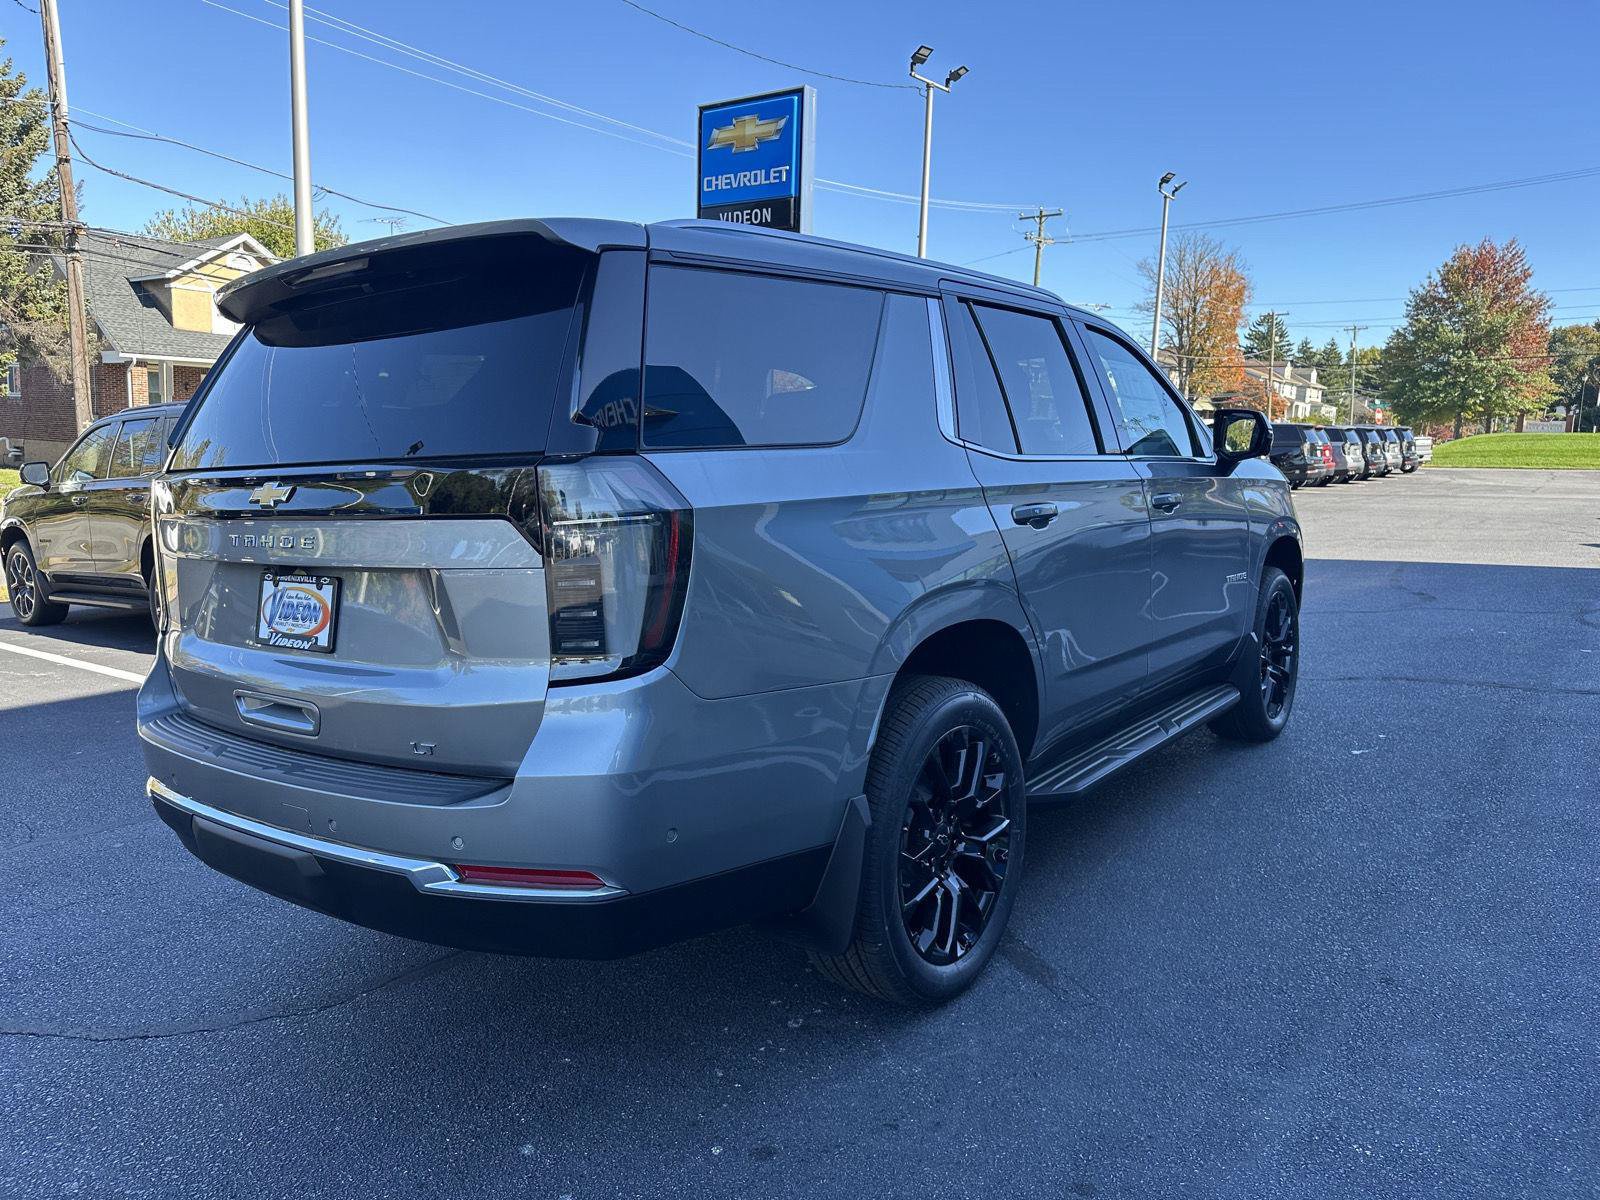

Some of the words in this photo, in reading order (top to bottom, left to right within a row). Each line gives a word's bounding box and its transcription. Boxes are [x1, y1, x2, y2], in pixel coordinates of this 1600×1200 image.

[703, 165, 790, 192] CHEVROLET
[719, 207, 772, 225] VIDEON
[229, 534, 317, 549] TAHOE
[269, 632, 312, 650] VIDEON
[409, 741, 437, 755] LT
